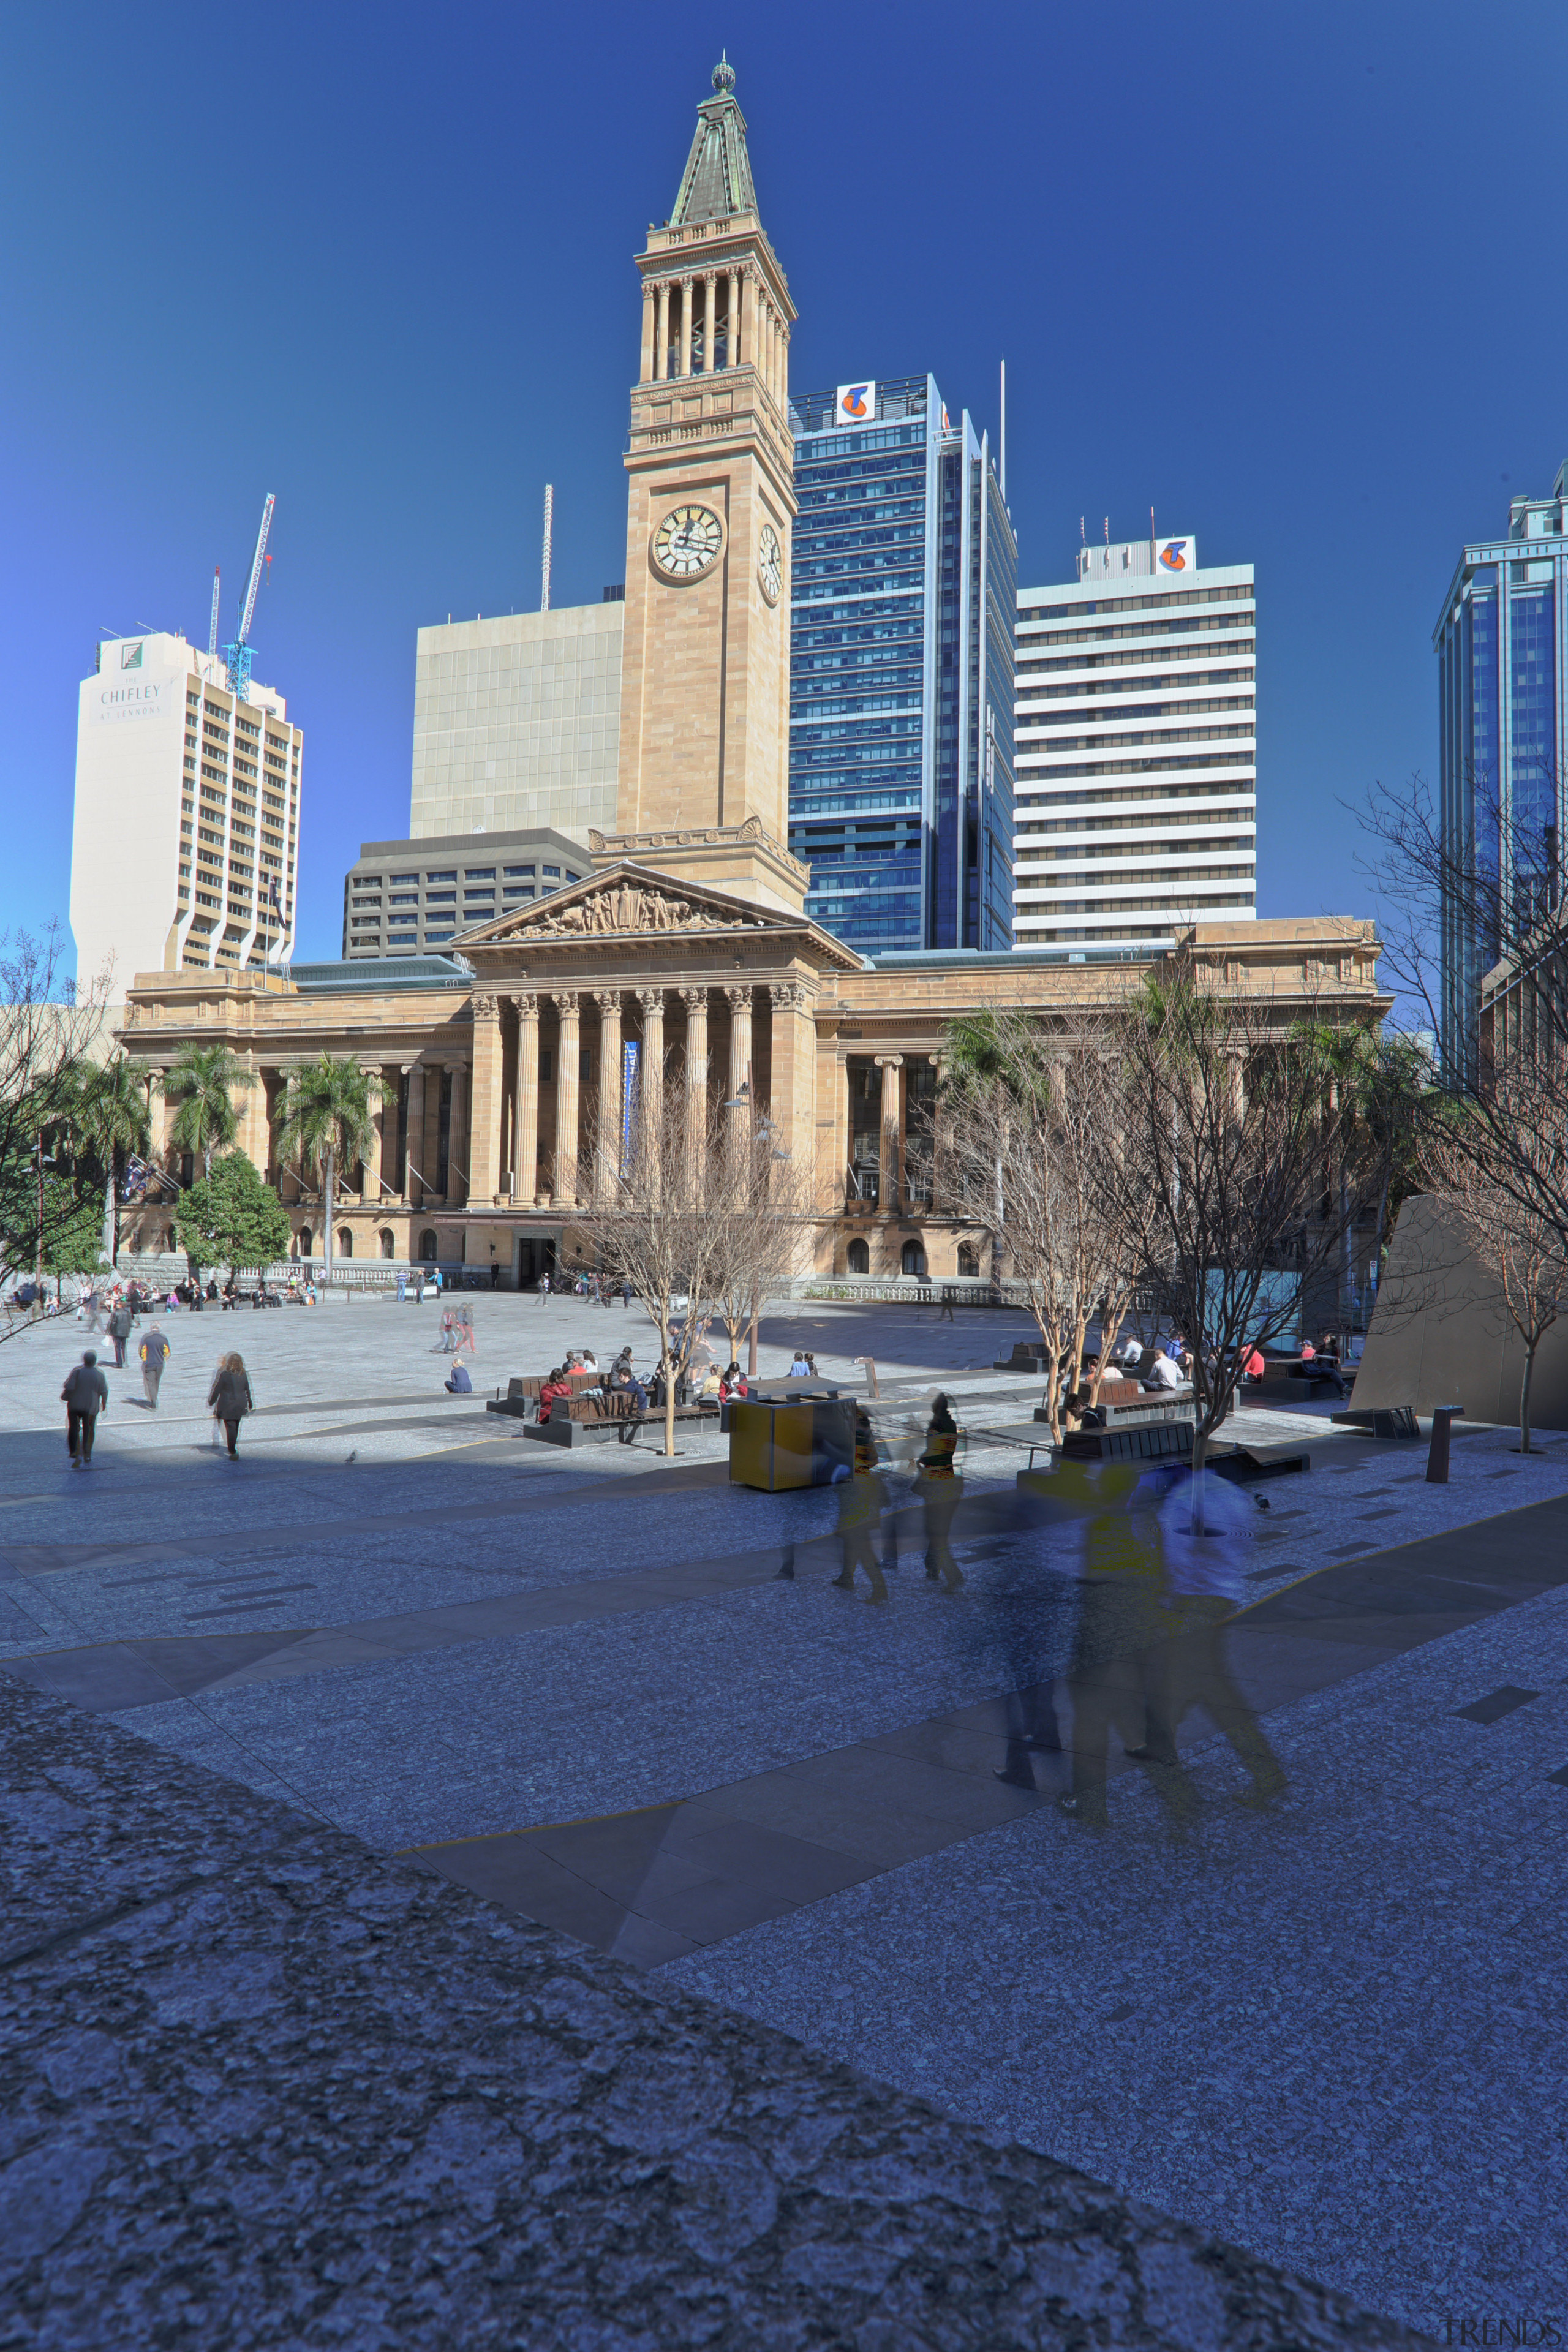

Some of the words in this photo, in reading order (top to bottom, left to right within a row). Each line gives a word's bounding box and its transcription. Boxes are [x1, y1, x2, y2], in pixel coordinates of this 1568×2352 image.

[100, 685, 161, 704] CHIFLEY
[117, 706, 161, 718] LENNONS
[628, 1049, 637, 1075] HALL
